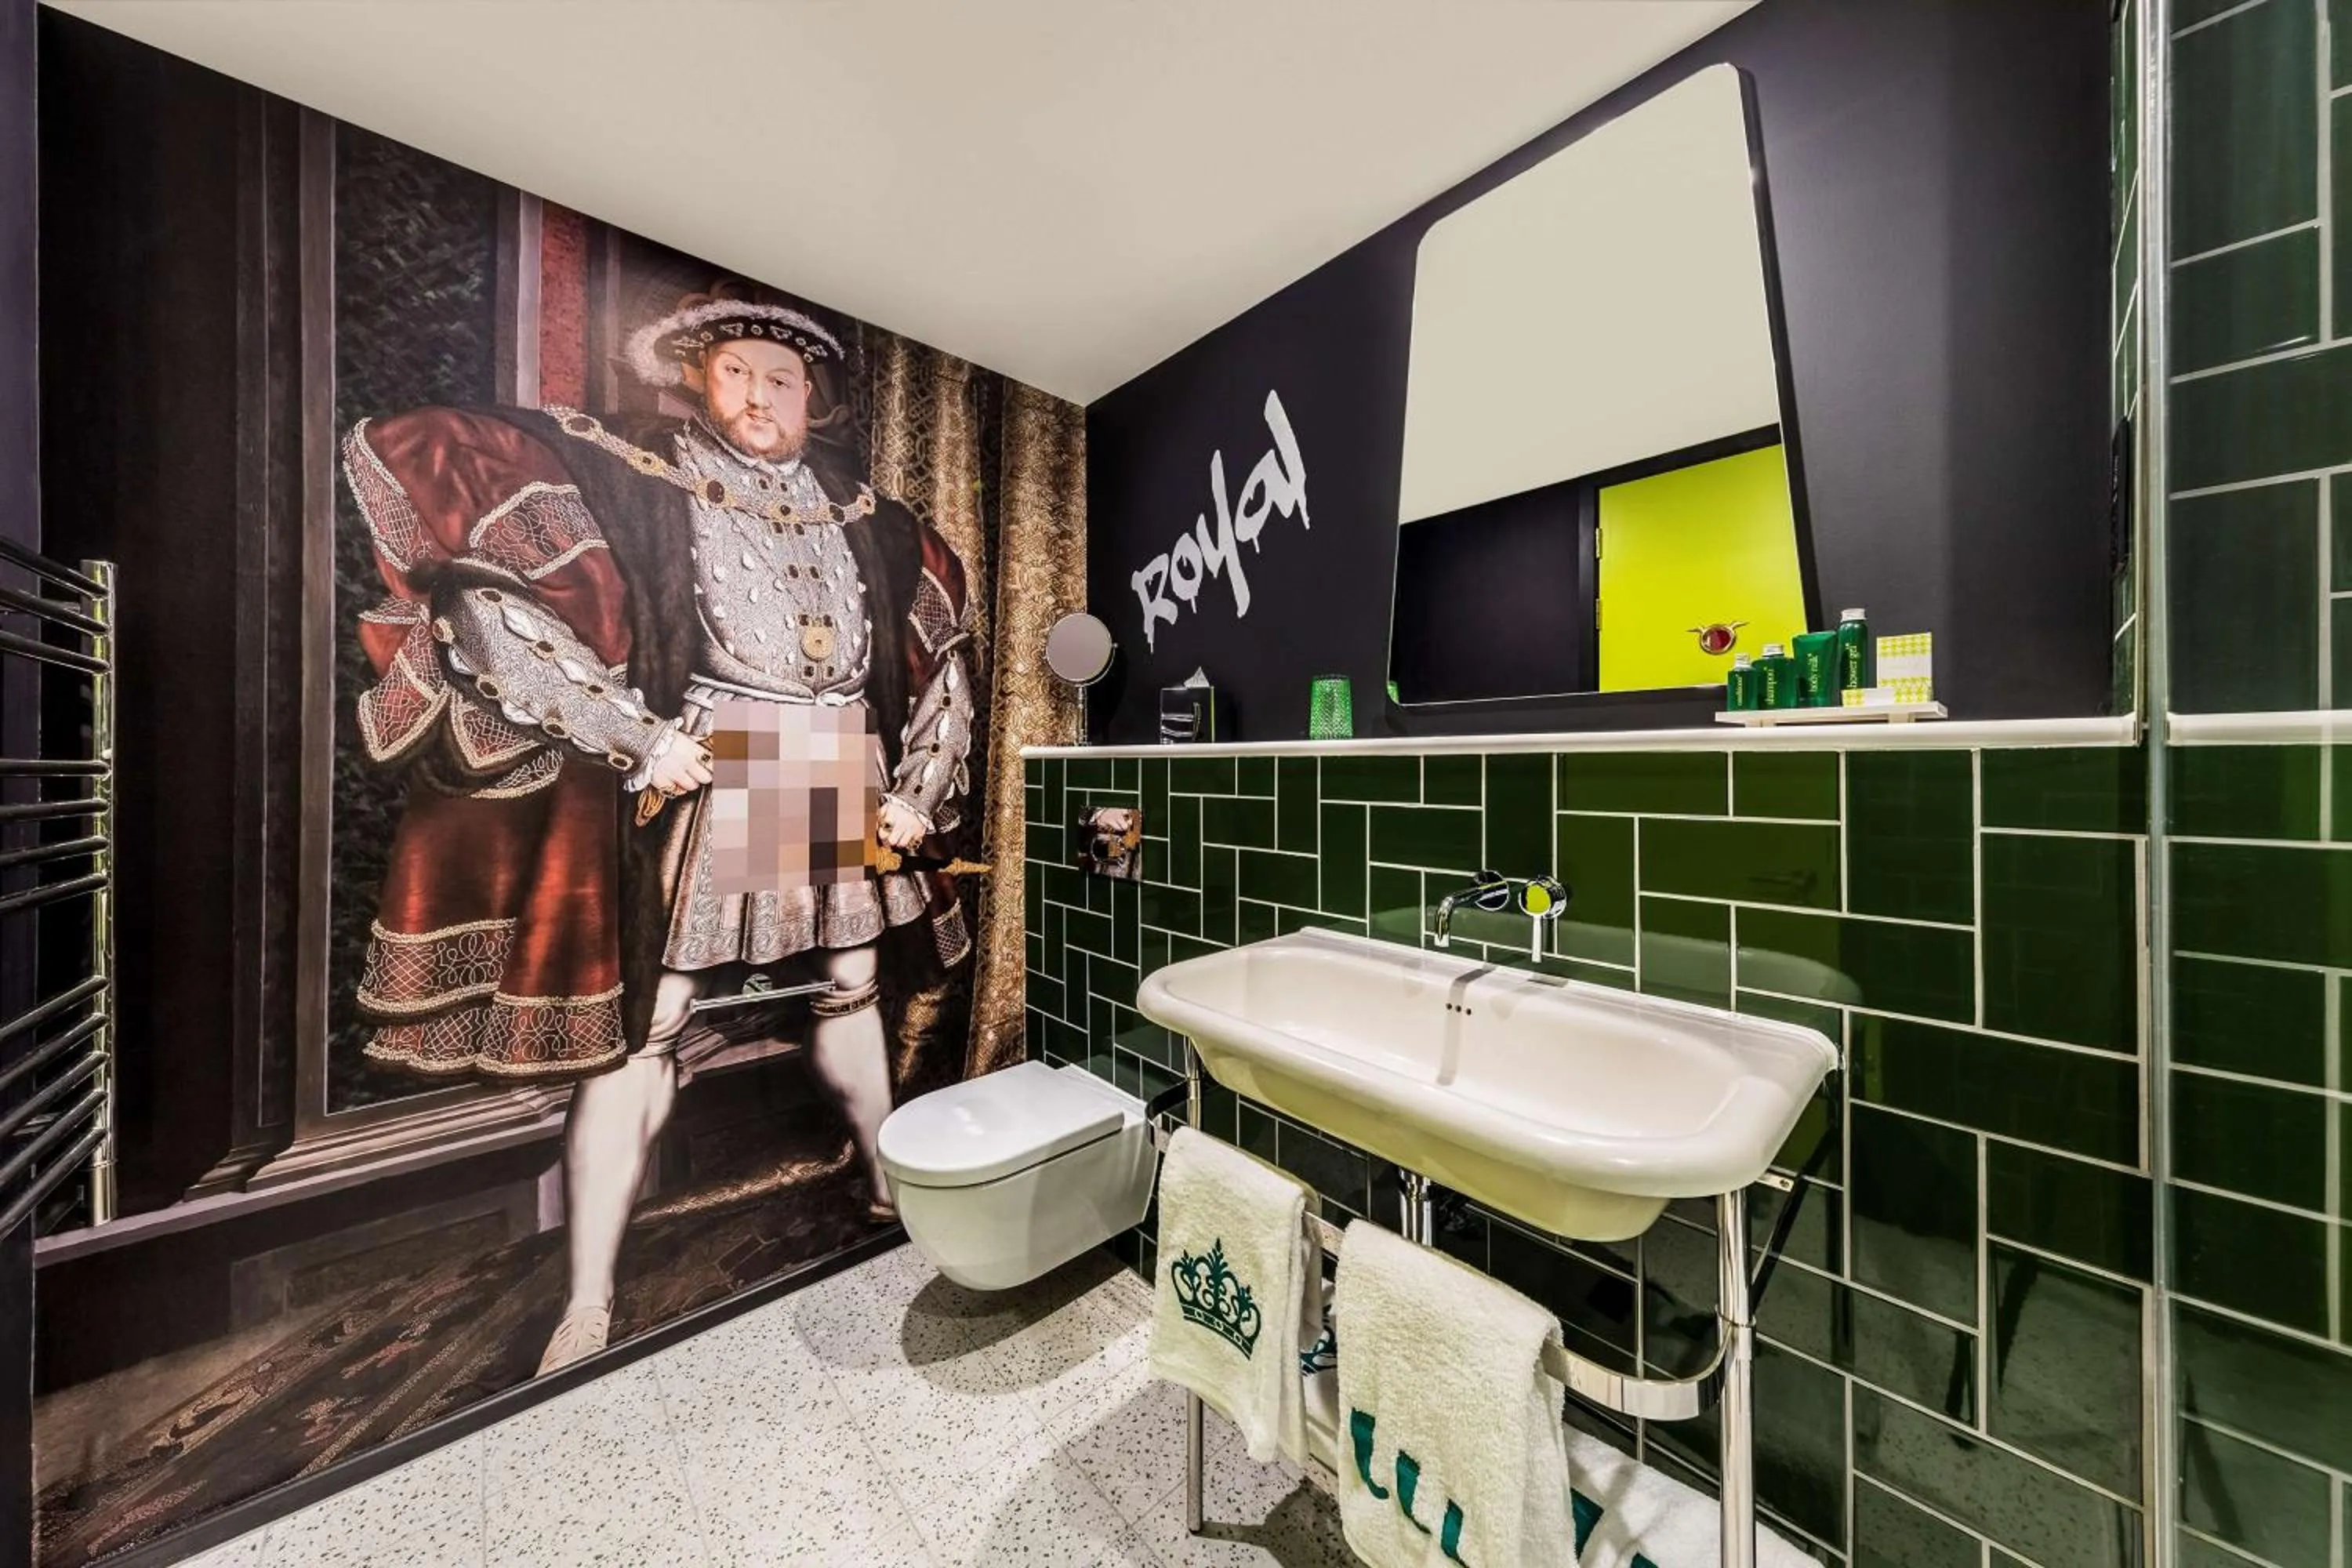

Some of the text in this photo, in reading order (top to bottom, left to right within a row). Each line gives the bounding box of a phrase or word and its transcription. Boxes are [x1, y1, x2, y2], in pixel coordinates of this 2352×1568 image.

[1846, 644, 1860, 688] hower gel
[1808, 673, 1820, 692] body
